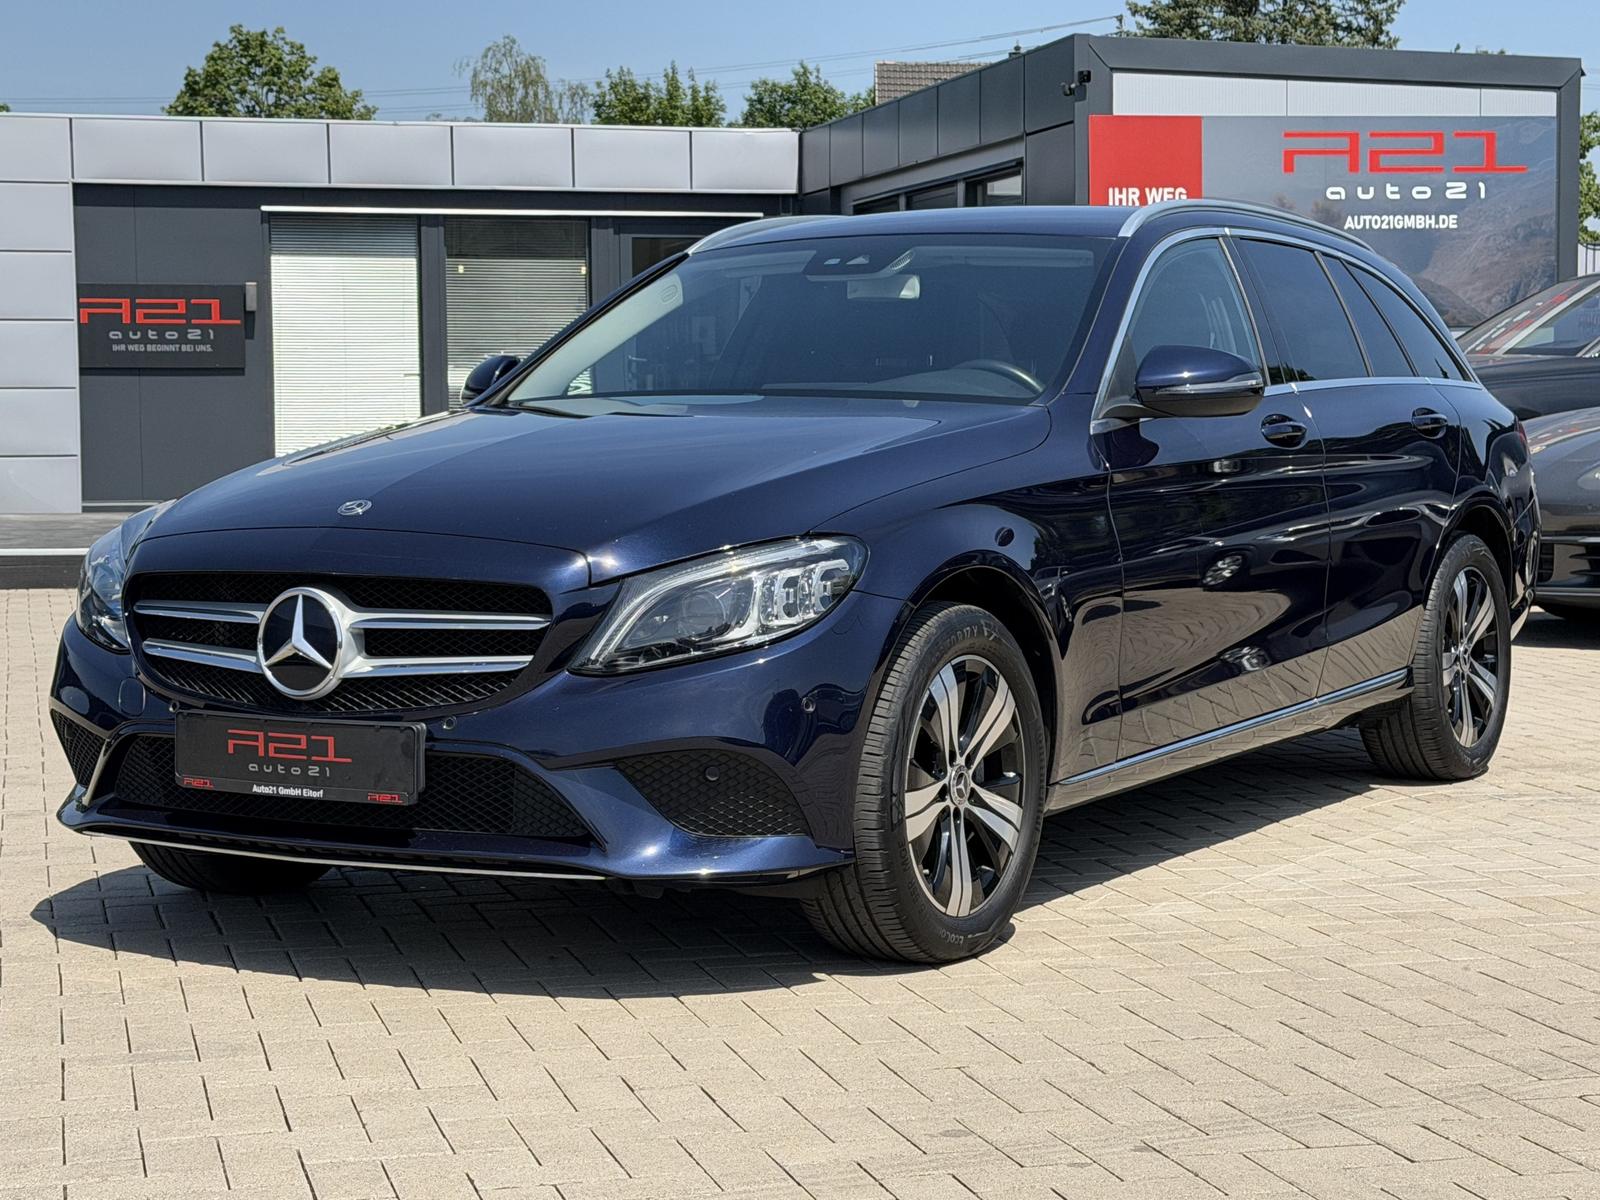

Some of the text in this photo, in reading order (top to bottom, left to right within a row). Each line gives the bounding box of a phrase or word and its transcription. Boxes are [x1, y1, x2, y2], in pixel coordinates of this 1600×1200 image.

[1282, 131, 1528, 174] A21
[1108, 187, 1140, 206] IHR
[1344, 214, 1457, 230] AUTO21GMBH.DE
[79, 298, 241, 324] A21
[112, 344, 214, 353] IHR WEG BEGINNT BEI UNS.
[228, 729, 352, 763] A21
[252, 784, 323, 798] Auto21 GmbH Eitorf
